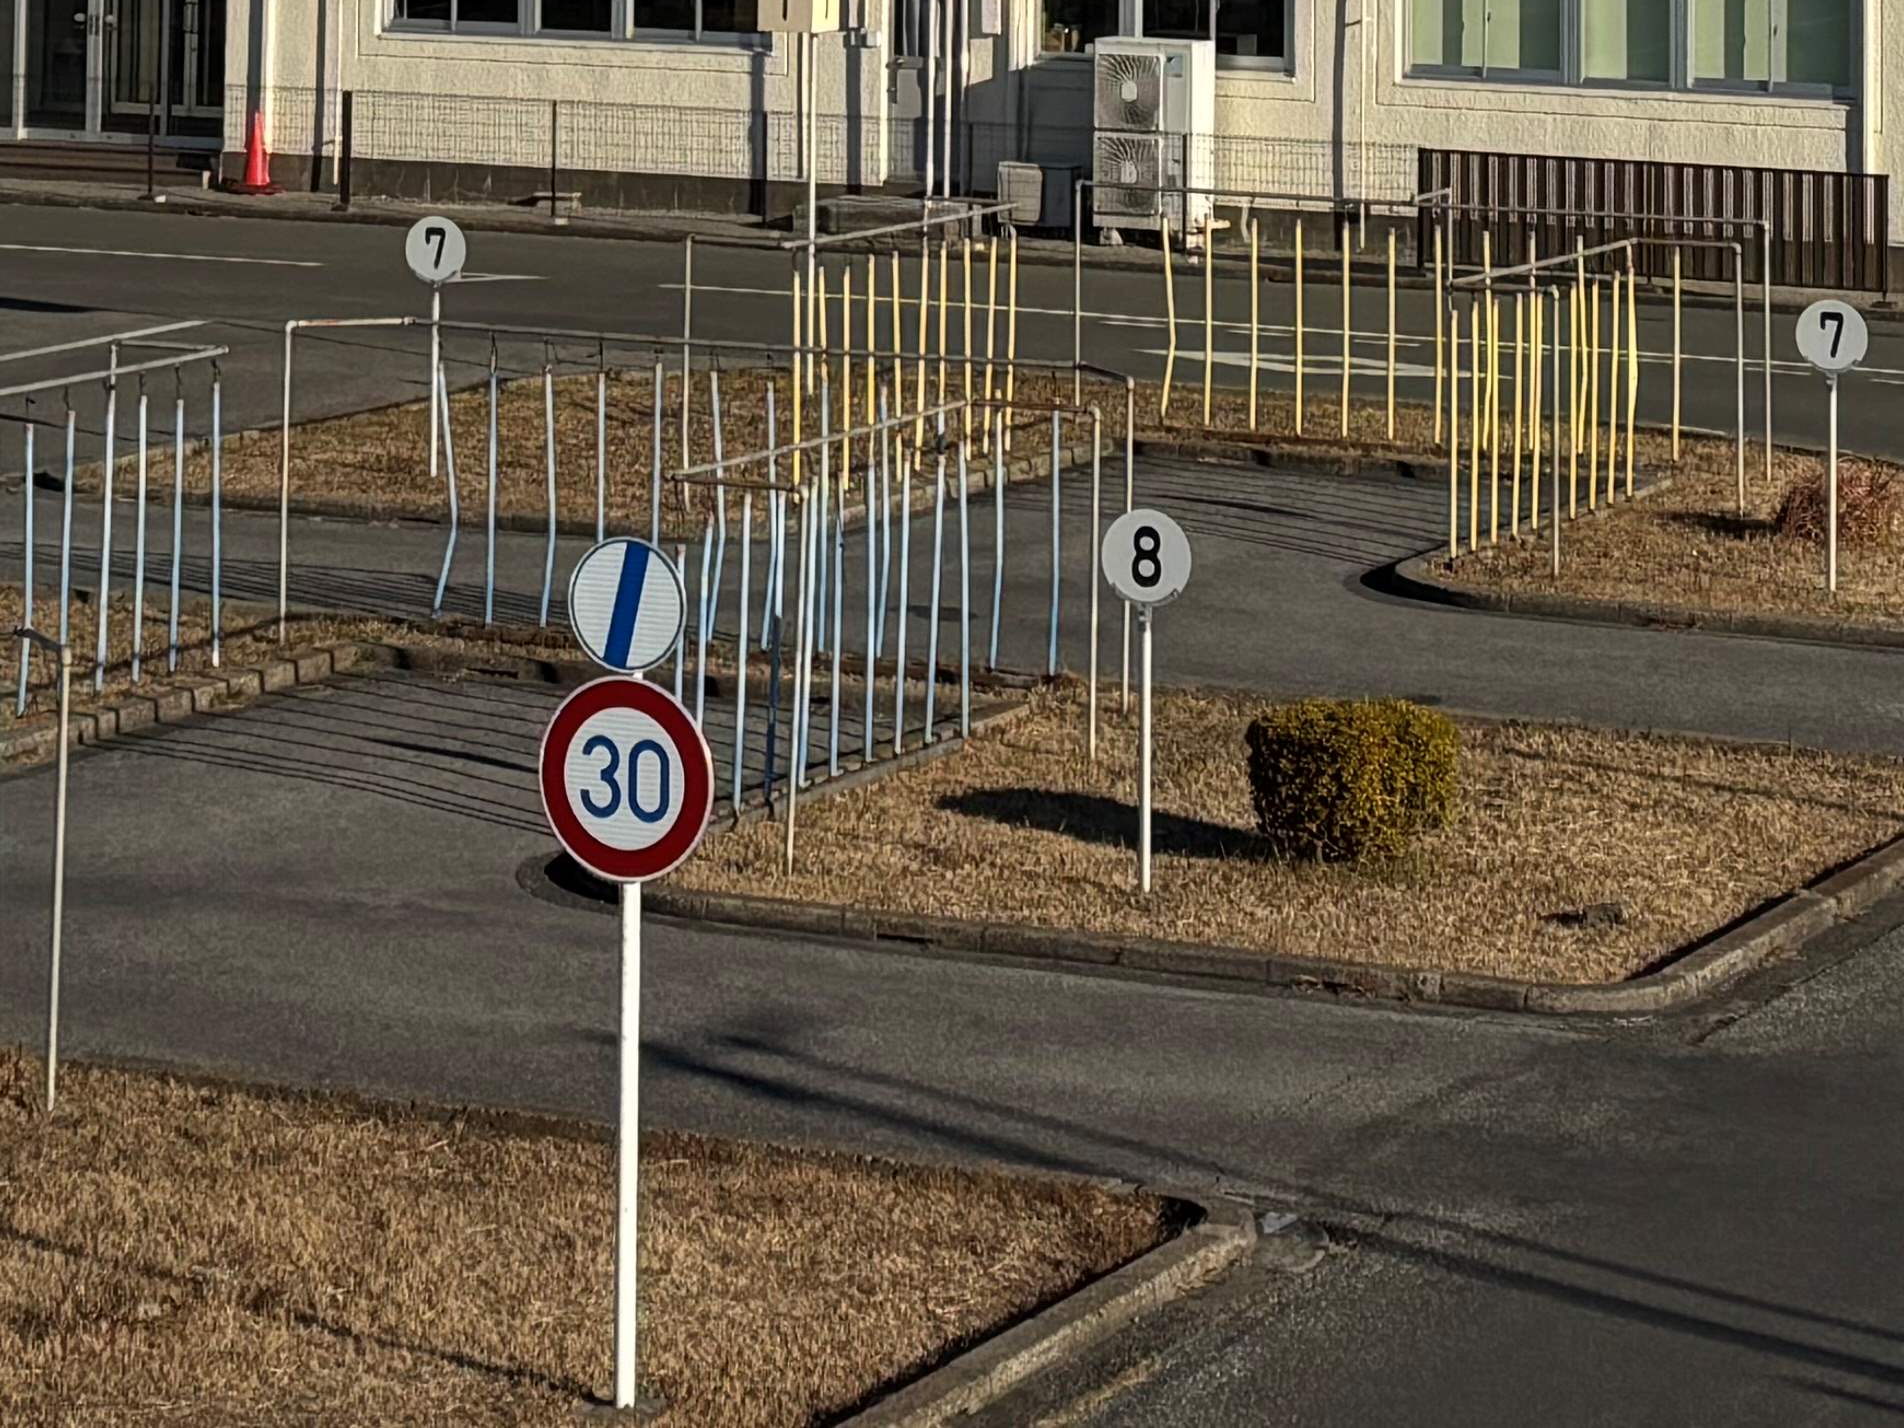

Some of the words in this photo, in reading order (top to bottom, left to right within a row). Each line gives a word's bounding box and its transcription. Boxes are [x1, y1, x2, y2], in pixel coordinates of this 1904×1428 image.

[425, 227, 446, 270] 7
[1820, 311, 1844, 358] 7
[1131, 525, 1162, 588] 8
[580, 734, 670, 823] 30
